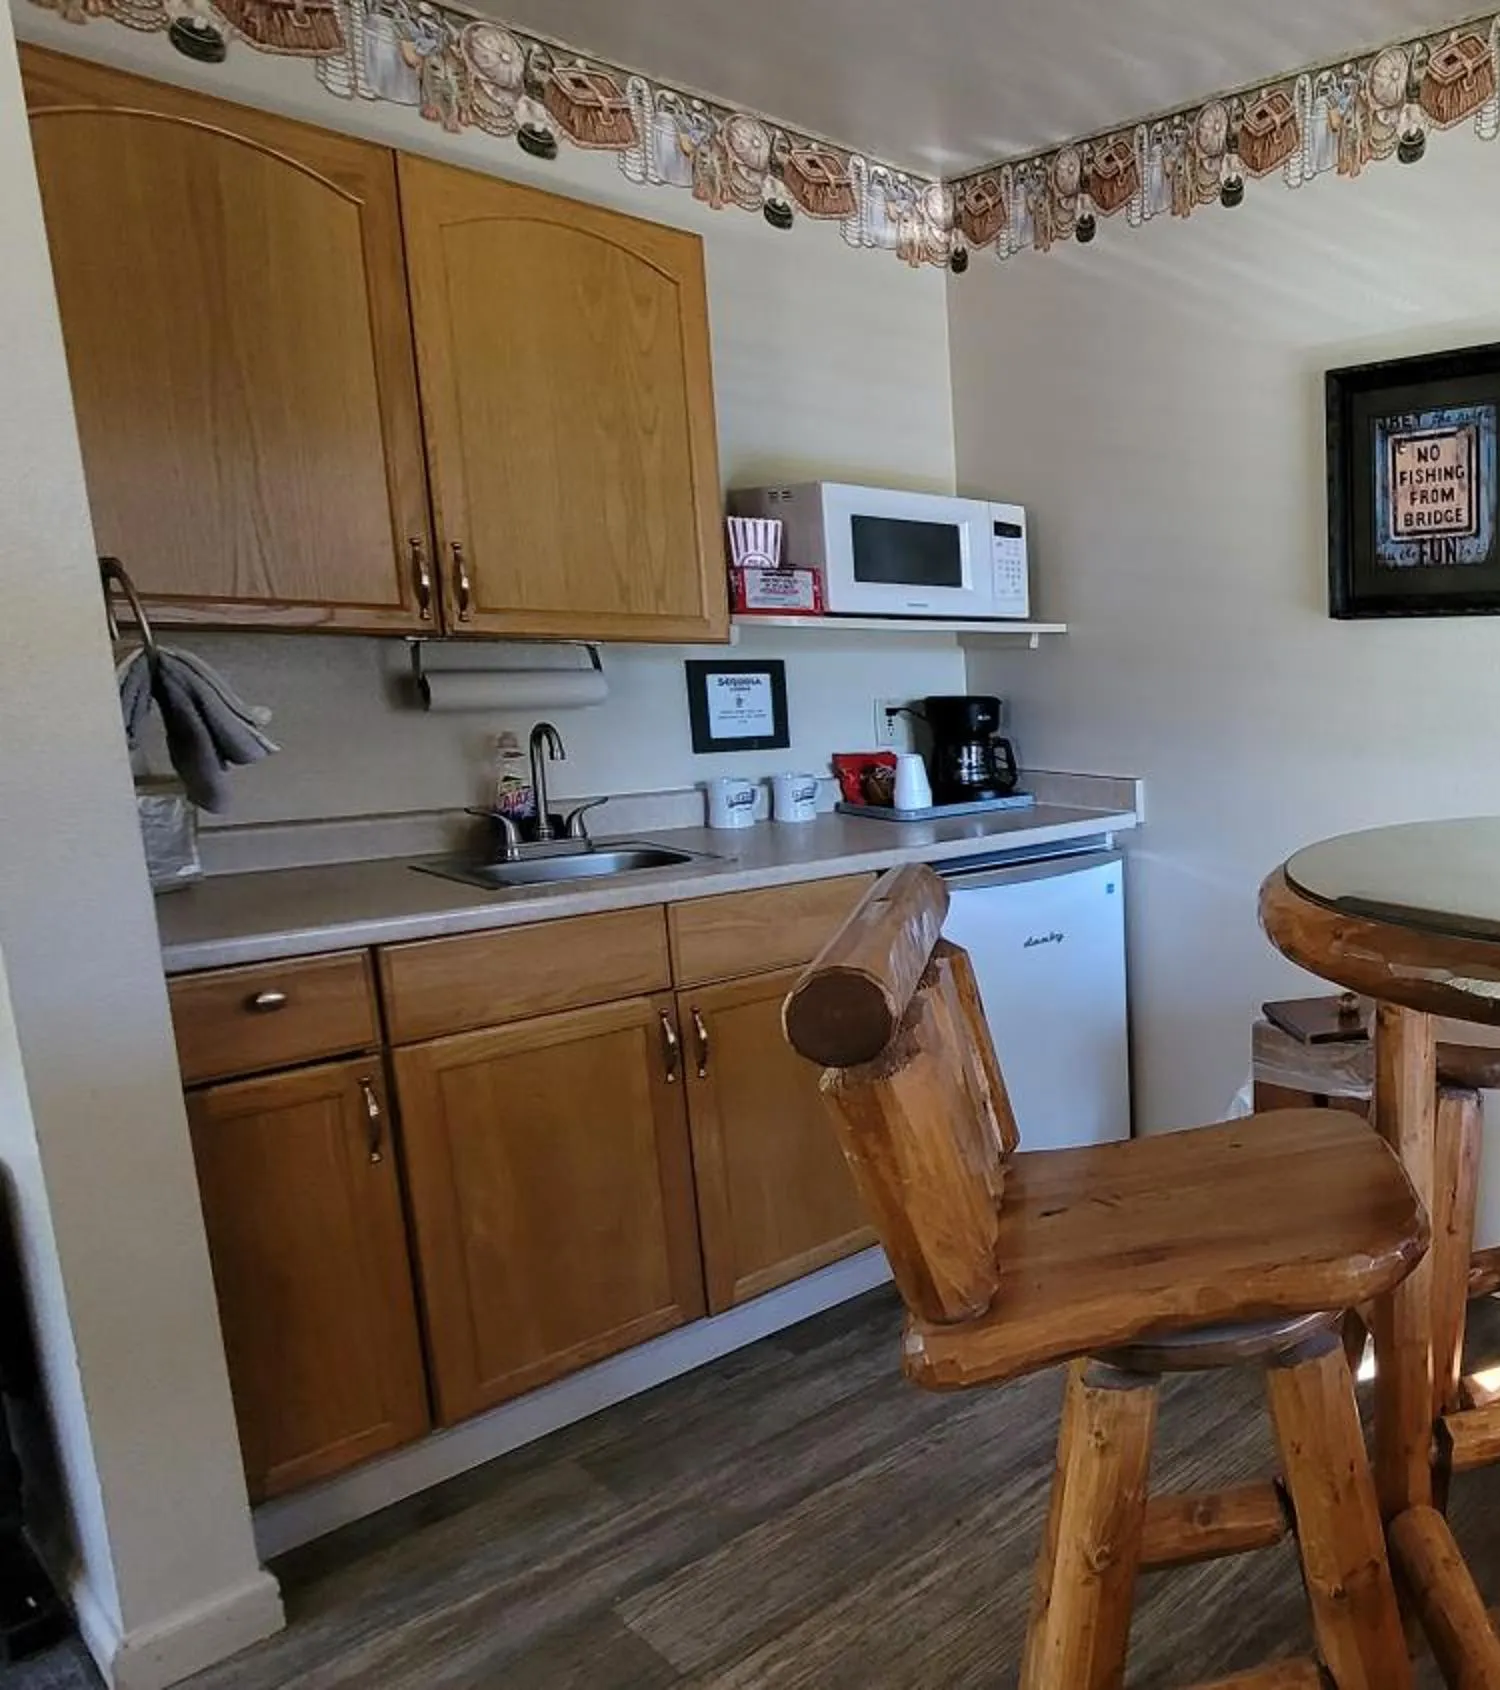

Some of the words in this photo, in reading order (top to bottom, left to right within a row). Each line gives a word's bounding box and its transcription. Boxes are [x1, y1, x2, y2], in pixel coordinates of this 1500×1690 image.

[1417, 444, 1441, 463] NO
[1400, 465, 1465, 486] FISHING
[1409, 487, 1455, 506] FROM
[1403, 508, 1464, 527] BRIDGE
[1419, 536, 1458, 564] FUN
